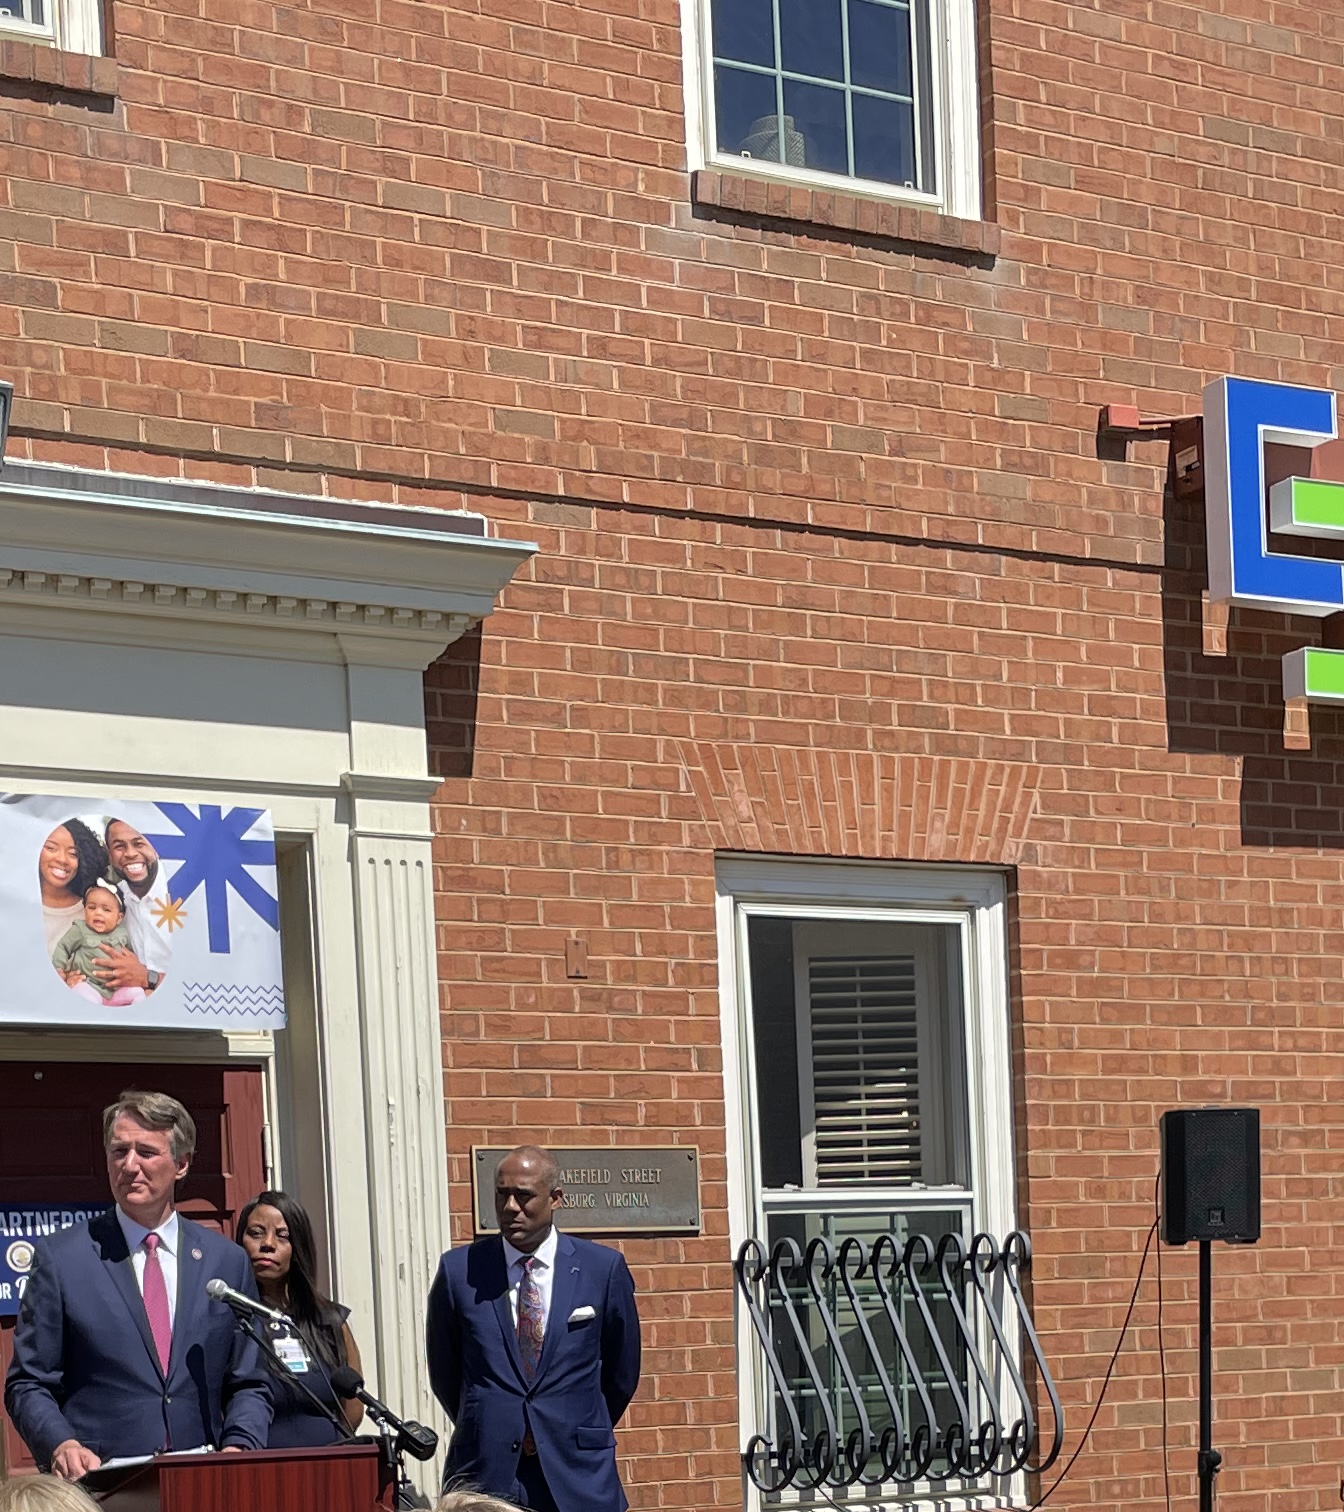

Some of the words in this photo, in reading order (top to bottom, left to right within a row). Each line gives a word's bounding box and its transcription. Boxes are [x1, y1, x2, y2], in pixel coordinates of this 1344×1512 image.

[559, 1168, 611, 1184] AKEFIELD
[621, 1168, 662, 1184] STREET
[562, 1193, 596, 1208] SBURG
[605, 1193, 650, 1208] VIRGINIA
